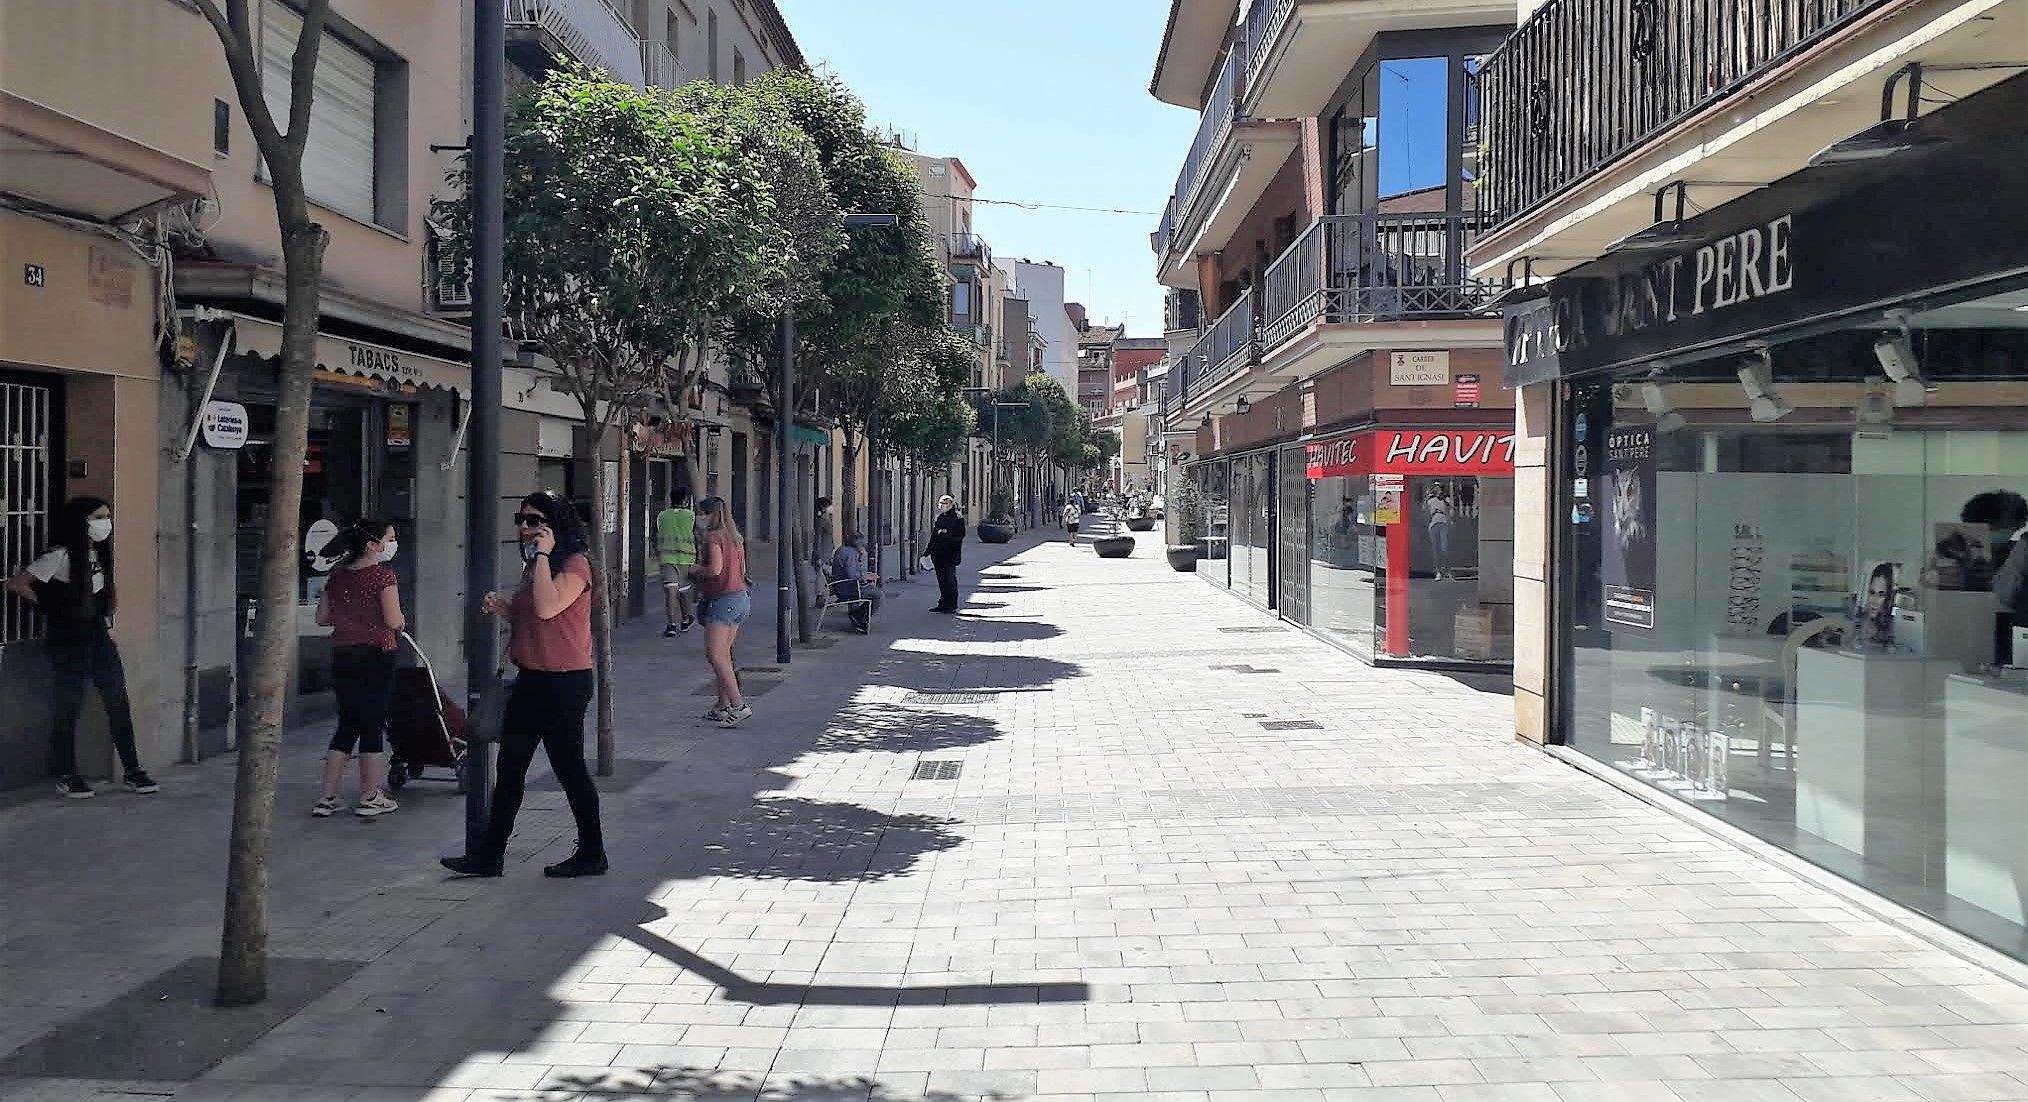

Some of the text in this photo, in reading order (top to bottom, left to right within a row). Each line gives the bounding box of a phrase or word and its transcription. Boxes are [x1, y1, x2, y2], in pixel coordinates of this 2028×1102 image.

[27, 265, 44, 286] 34
[1691, 213, 1793, 317] PERE
[349, 345, 400, 373] TABACS
[1308, 439, 1358, 469] HAVITEC
